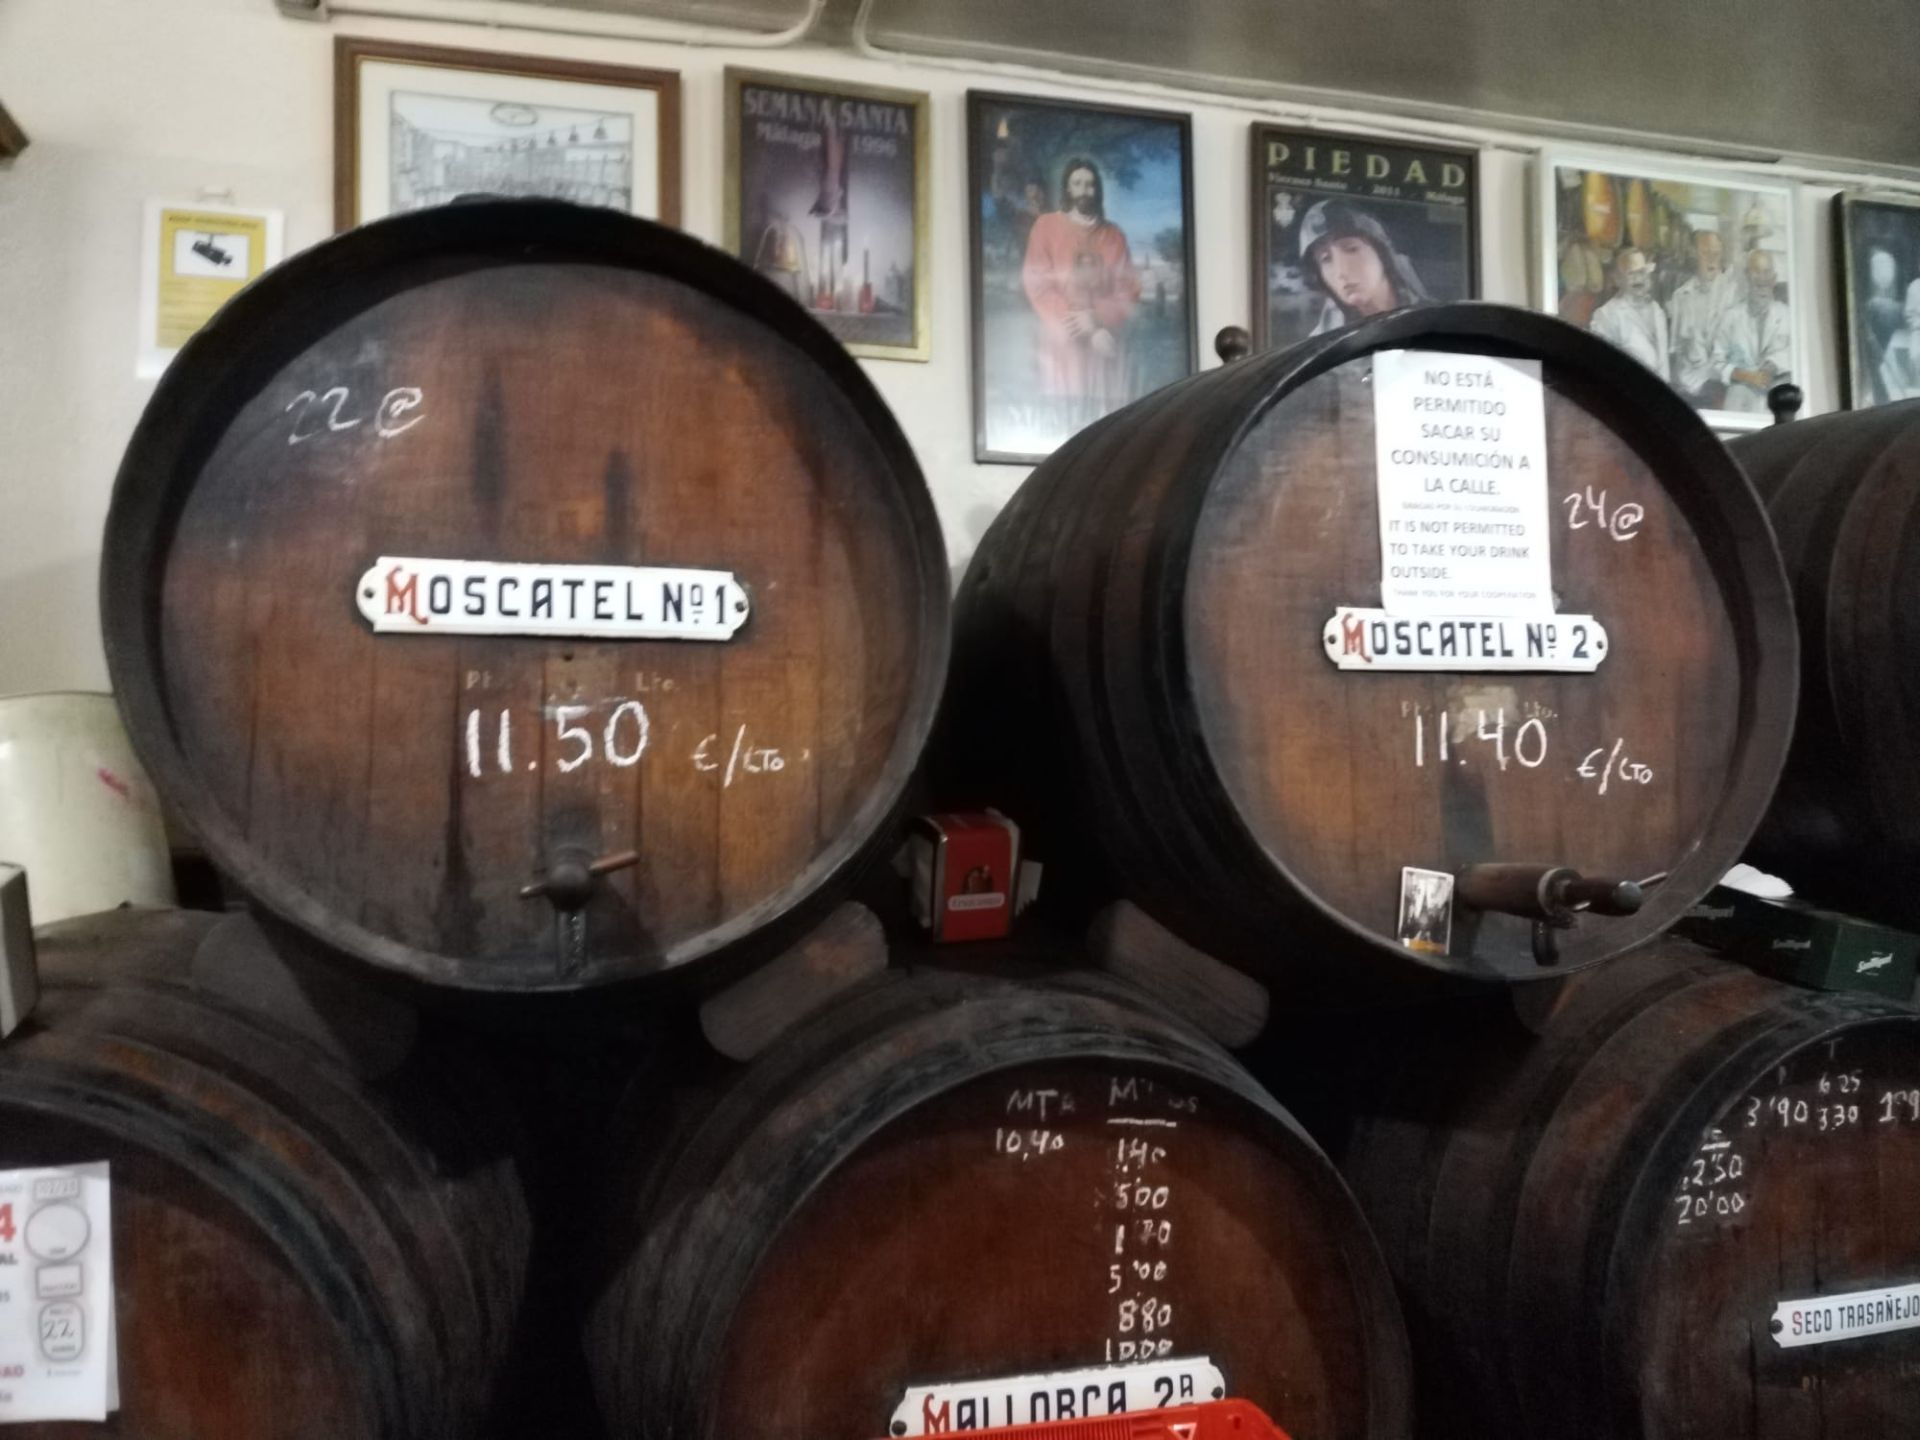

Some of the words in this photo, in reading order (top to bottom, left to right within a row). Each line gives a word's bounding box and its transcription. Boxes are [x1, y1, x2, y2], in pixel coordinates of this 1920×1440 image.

[744, 87, 837, 128] SEMANA
[840, 101, 909, 135] SANTA
[1267, 141, 1467, 188] PIEDAD
[1425, 370, 1450, 386] NO
[1456, 369, 1494, 388] ESTÁ
[285, 386, 363, 445] 22
[1413, 396, 1506, 416] PERMITIDO
[1421, 423, 1475, 440] SACAR
[1480, 426, 1501, 442] SU
[1391, 449, 1513, 469] CONSUMICIÓN
[1519, 455, 1530, 469] A
[1425, 477, 1444, 493] LA
[1449, 478, 1501, 495] CALLE.
[1389, 519, 1401, 532] IT
[1405, 520, 1417, 533] IS
[1420, 520, 1449, 534] NOT
[1453, 521, 1525, 537] PERMITTED
[1390, 542, 1408, 556] TO
[1412, 543, 1445, 556] TAKE
[1450, 544, 1486, 558] YOUR
[1490, 545, 1530, 559] DRINK
[385, 565, 644, 625] MOSCATEL
[1341, 613, 1514, 664] MOSCATEL
[1573, 624, 1590, 660] 2
[465, 700, 650, 779] 11.50
[1415, 707, 1548, 771] 11.40
[1792, 1308, 1833, 1337] SECO
[1838, 1293, 1920, 1330] TRASAÑEJO
